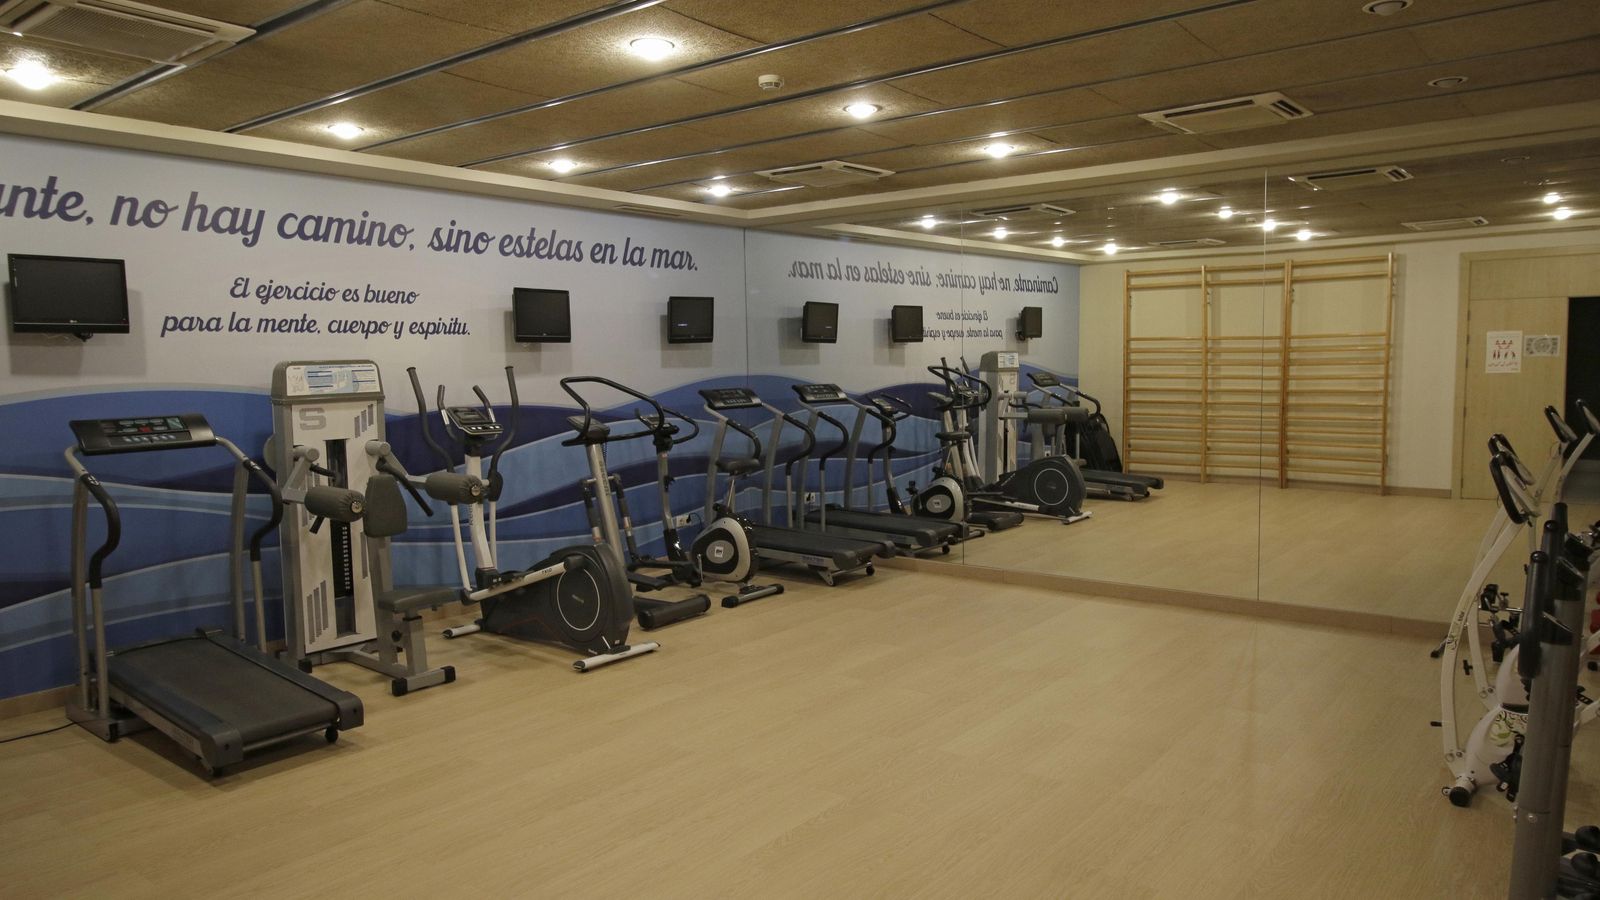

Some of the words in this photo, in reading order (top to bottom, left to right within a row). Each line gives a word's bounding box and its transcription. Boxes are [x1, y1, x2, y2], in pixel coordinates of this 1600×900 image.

[109, 194, 180, 229] no
[181, 190, 266, 248] hay
[276, 210, 415, 251] camino,
[426, 219, 497, 256] sino
[498, 227, 584, 263] estelas
[589, 242, 618, 265] en
[622, 236, 647, 268] la
[650, 247, 699, 272] mar.
[229, 277, 251, 299] El
[255, 279, 341, 305] ejercicio
[341, 288, 361, 303] es
[363, 284, 421, 304] bueno
[160, 315, 225, 338] para
[228, 311, 253, 333] la
[327, 320, 393, 341] cuerpo
[393, 320, 405, 340] y
[298, 406, 327, 431] S
